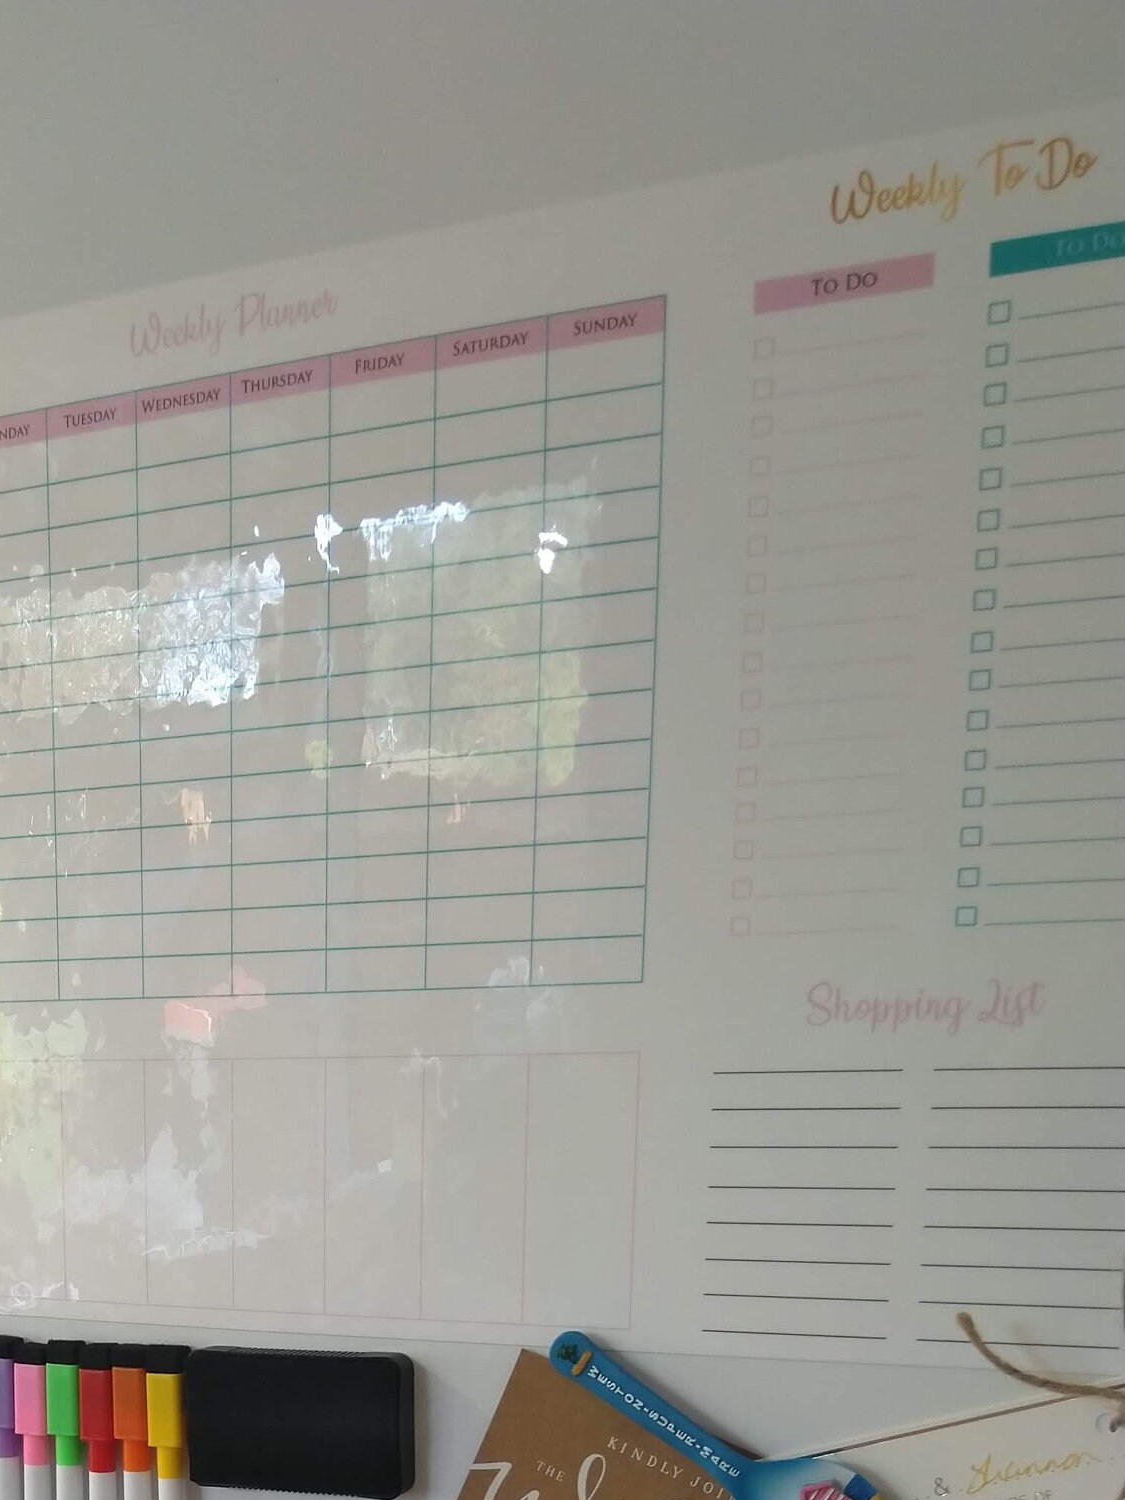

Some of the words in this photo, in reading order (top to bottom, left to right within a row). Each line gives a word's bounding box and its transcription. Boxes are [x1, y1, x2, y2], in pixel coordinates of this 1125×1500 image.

[830, 158, 969, 225] Weekly
[978, 139, 1034, 197] To
[1035, 136, 1099, 192] Do
[811, 277, 838, 297] TO
[846, 271, 878, 292] DO
[128, 306, 225, 358] Weekly
[234, 287, 339, 338] Planner
[63, 407, 118, 429] TUESDAY
[141, 388, 222, 414] WEDNESDAY
[241, 369, 315, 394] THURSDAY
[354, 353, 406, 375] FRIDAY
[452, 331, 529, 358] SATURDAY
[574, 312, 638, 337] SUNDAY
[805, 980, 970, 1036] Shopping
[976, 977, 1046, 1030] List
[587, 1365, 740, 1478] WESTON-SUPER-MARE
[536, 1460, 565, 1482] THE
[607, 1436, 684, 1479] KINDLY
[933, 1476, 951, 1497] &
